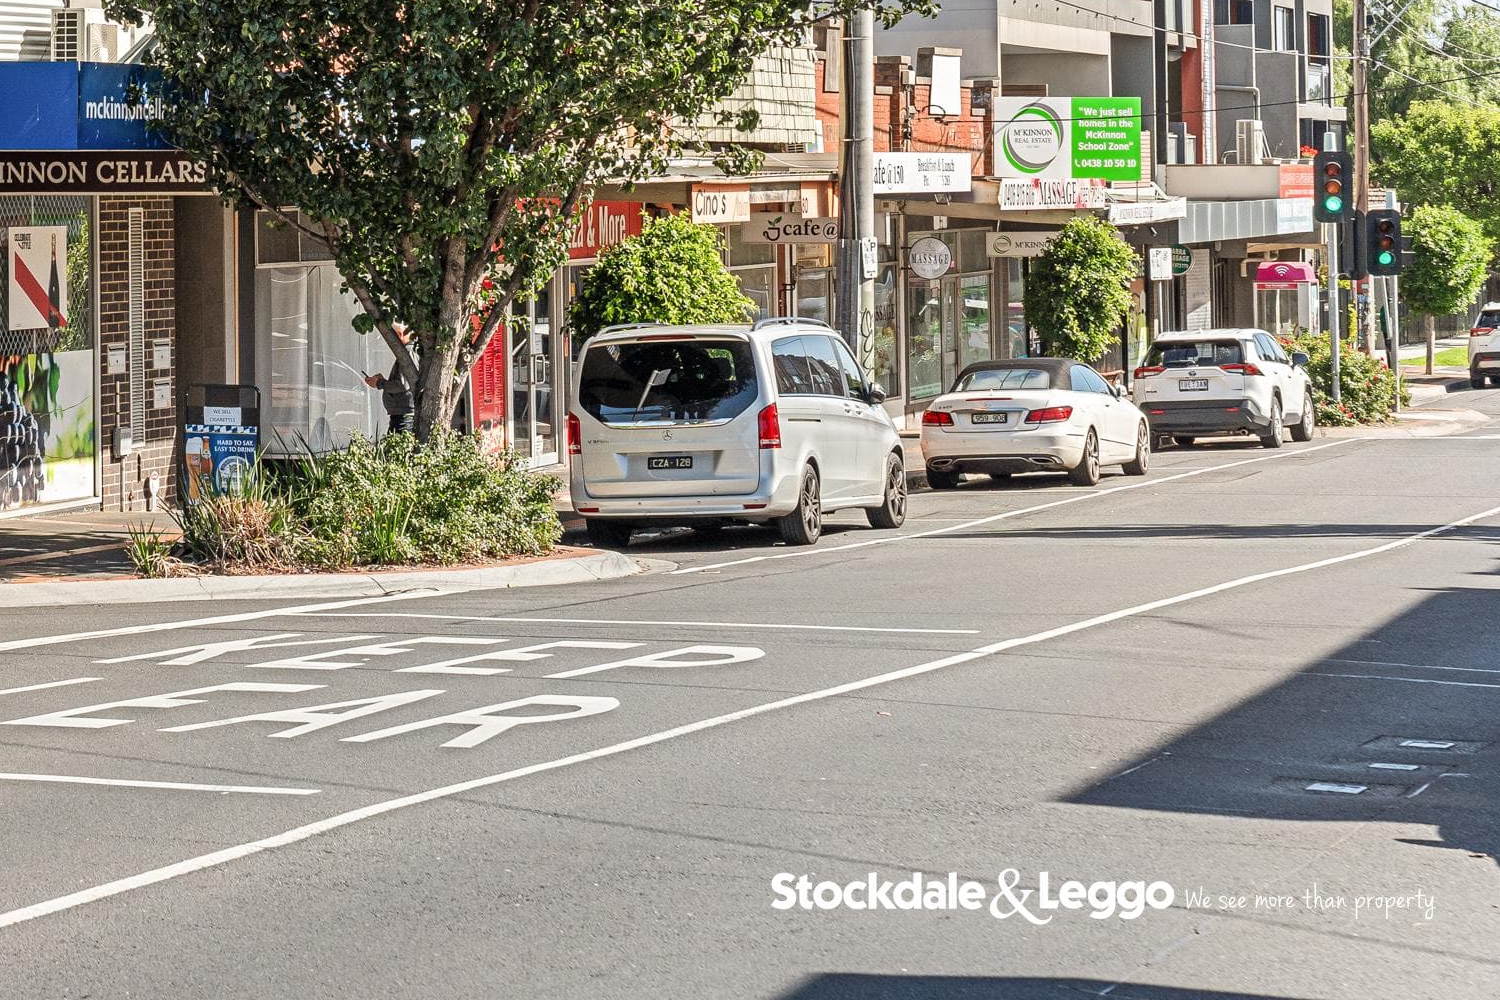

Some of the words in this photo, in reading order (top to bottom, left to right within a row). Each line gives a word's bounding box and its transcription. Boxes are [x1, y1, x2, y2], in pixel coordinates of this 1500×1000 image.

[1078, 119, 1106, 128] homes
[1108, 119, 1118, 127] in
[1119, 119, 1133, 128] the
[1099, 107, 1116, 118] just
[1117, 107, 1133, 116] sell
[1078, 142, 1106, 151] School
[1085, 131, 1126, 140] McKinnon
[96, 160, 207, 184] CELLARS
[874, 158, 886, 184] afe
[1081, 159, 1102, 168] 0438
[1104, 159, 1113, 168] 10
[1115, 159, 1125, 168] 50
[1127, 159, 1136, 168] 10
[695, 189, 727, 216] Cino's
[1039, 182, 1077, 205] MASSAGE
[587, 206, 595, 248] &
[599, 205, 626, 247] More
[783, 215, 820, 236] cafe
[822, 223, 838, 240] @
[911, 253, 949, 264] MASSAGE
[92, 632, 765, 679] KEEP
